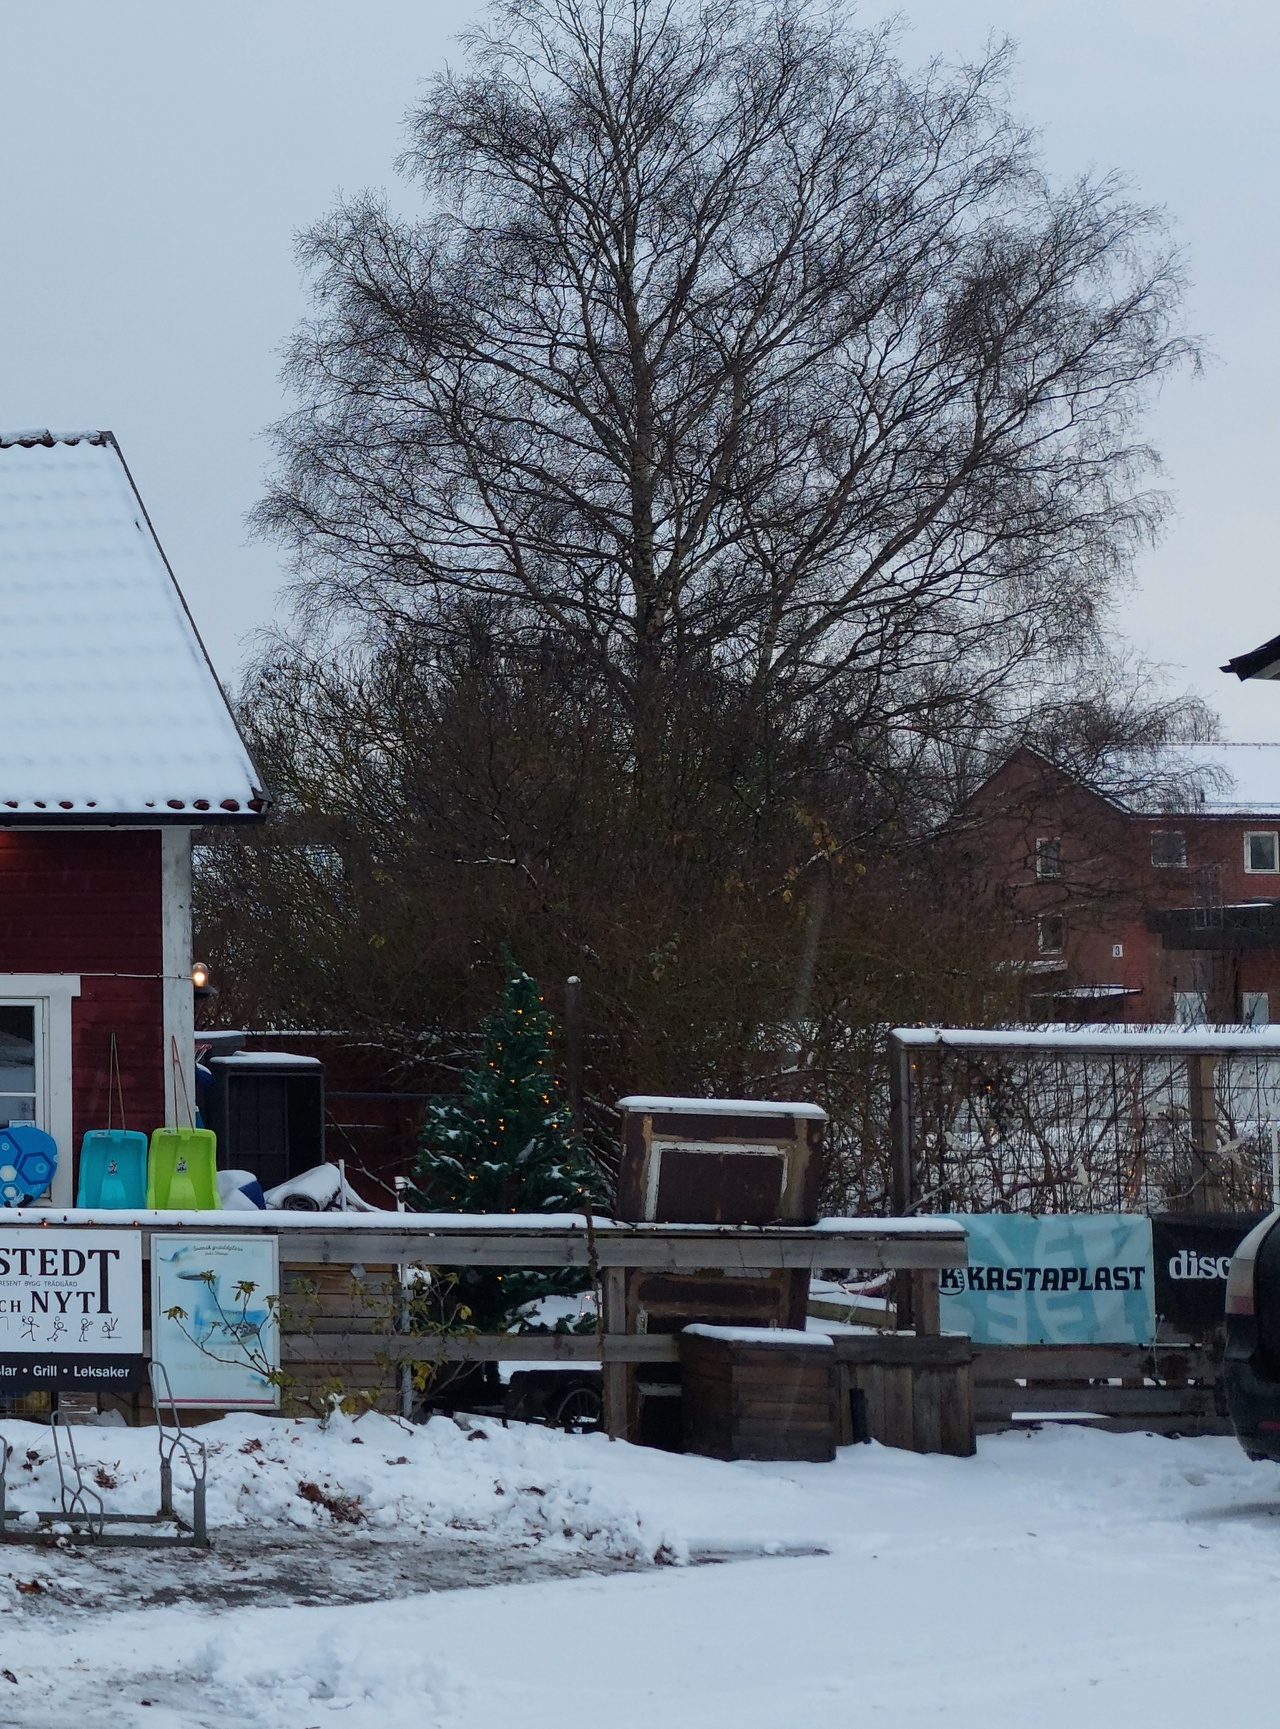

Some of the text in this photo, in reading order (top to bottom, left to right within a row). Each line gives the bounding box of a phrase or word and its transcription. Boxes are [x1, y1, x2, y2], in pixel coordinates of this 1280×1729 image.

[44, 1279, 78, 1287] TRÄDGÅRD
[968, 1266, 1145, 1290] KASTAPLAST
[33, 1365, 57, 1377] Grill
[74, 1366, 130, 1378] Leksaker
